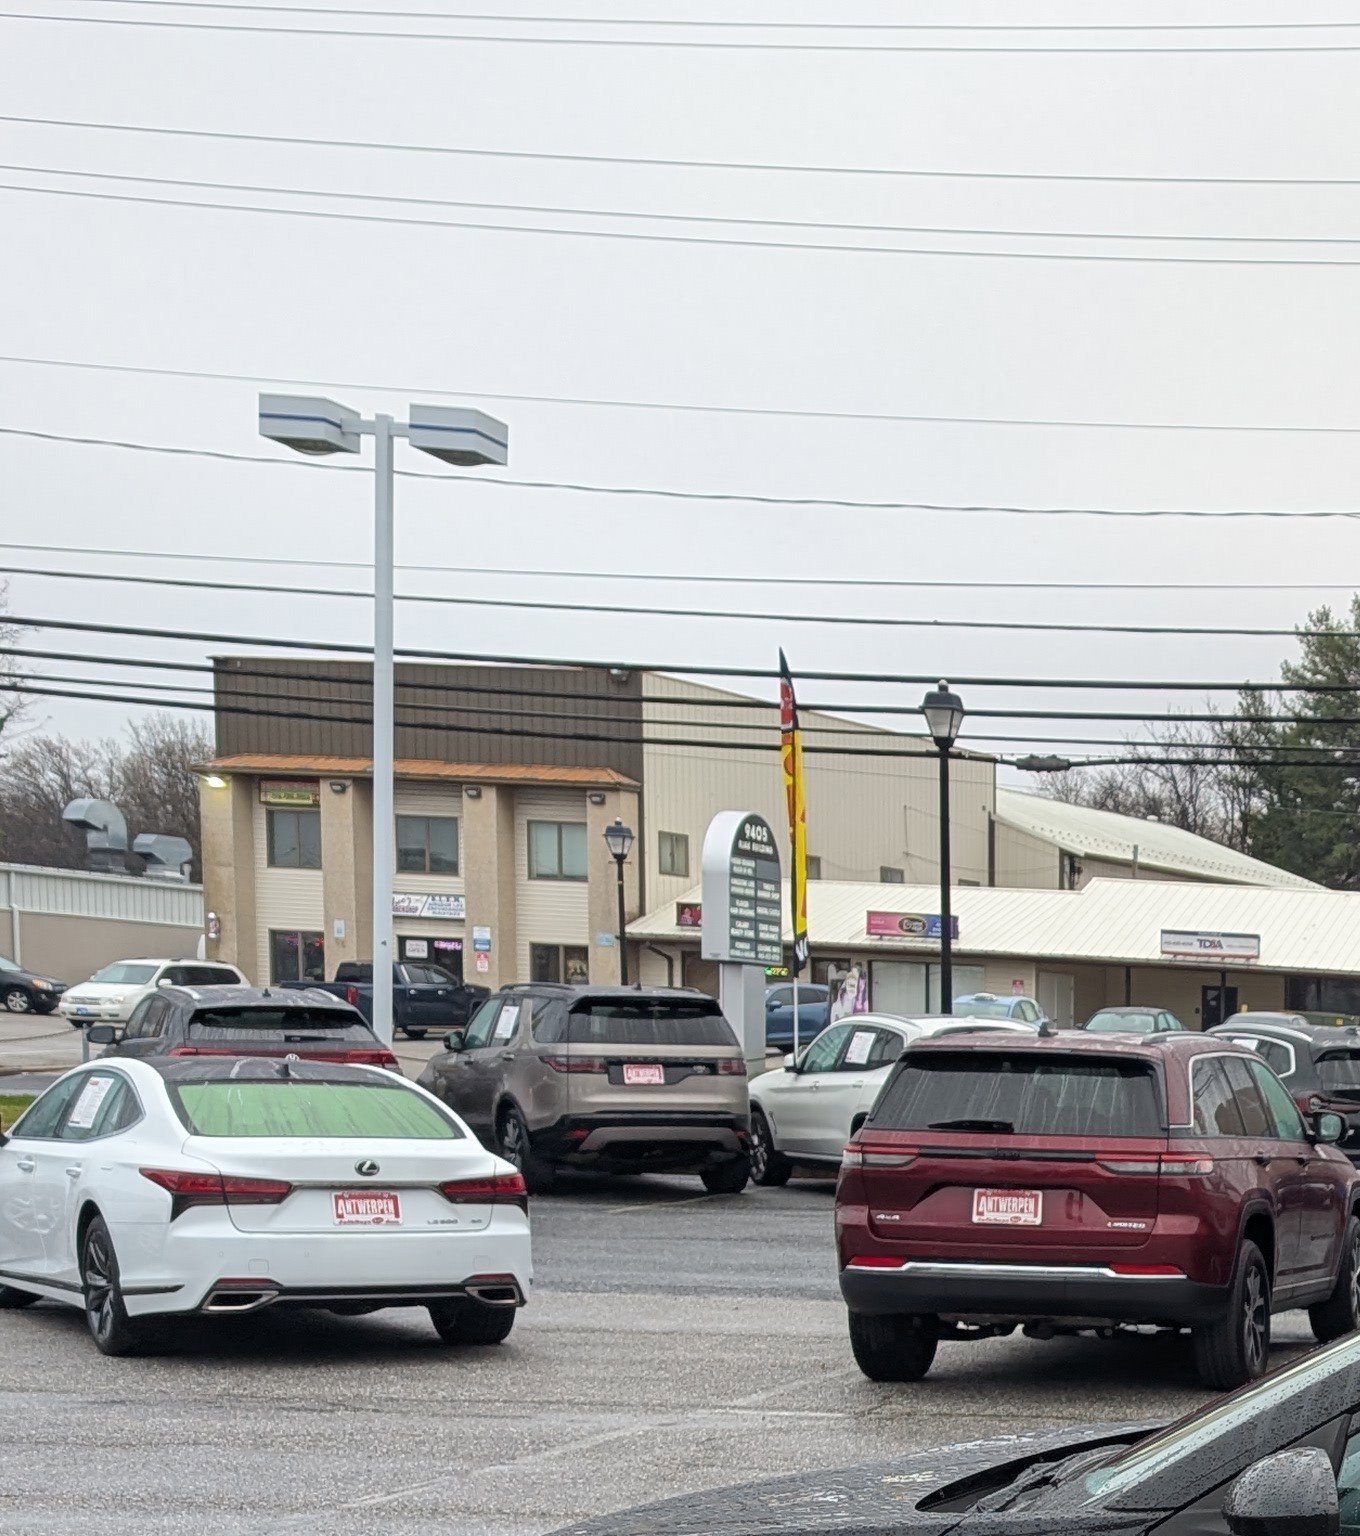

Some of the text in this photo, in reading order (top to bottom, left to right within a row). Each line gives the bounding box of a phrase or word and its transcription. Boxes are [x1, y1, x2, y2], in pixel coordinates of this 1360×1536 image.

[744, 822, 769, 842] 9405
[337, 1197, 394, 1216] ANTWERPEN
[978, 1194, 1036, 1214] ANTWERPEN
